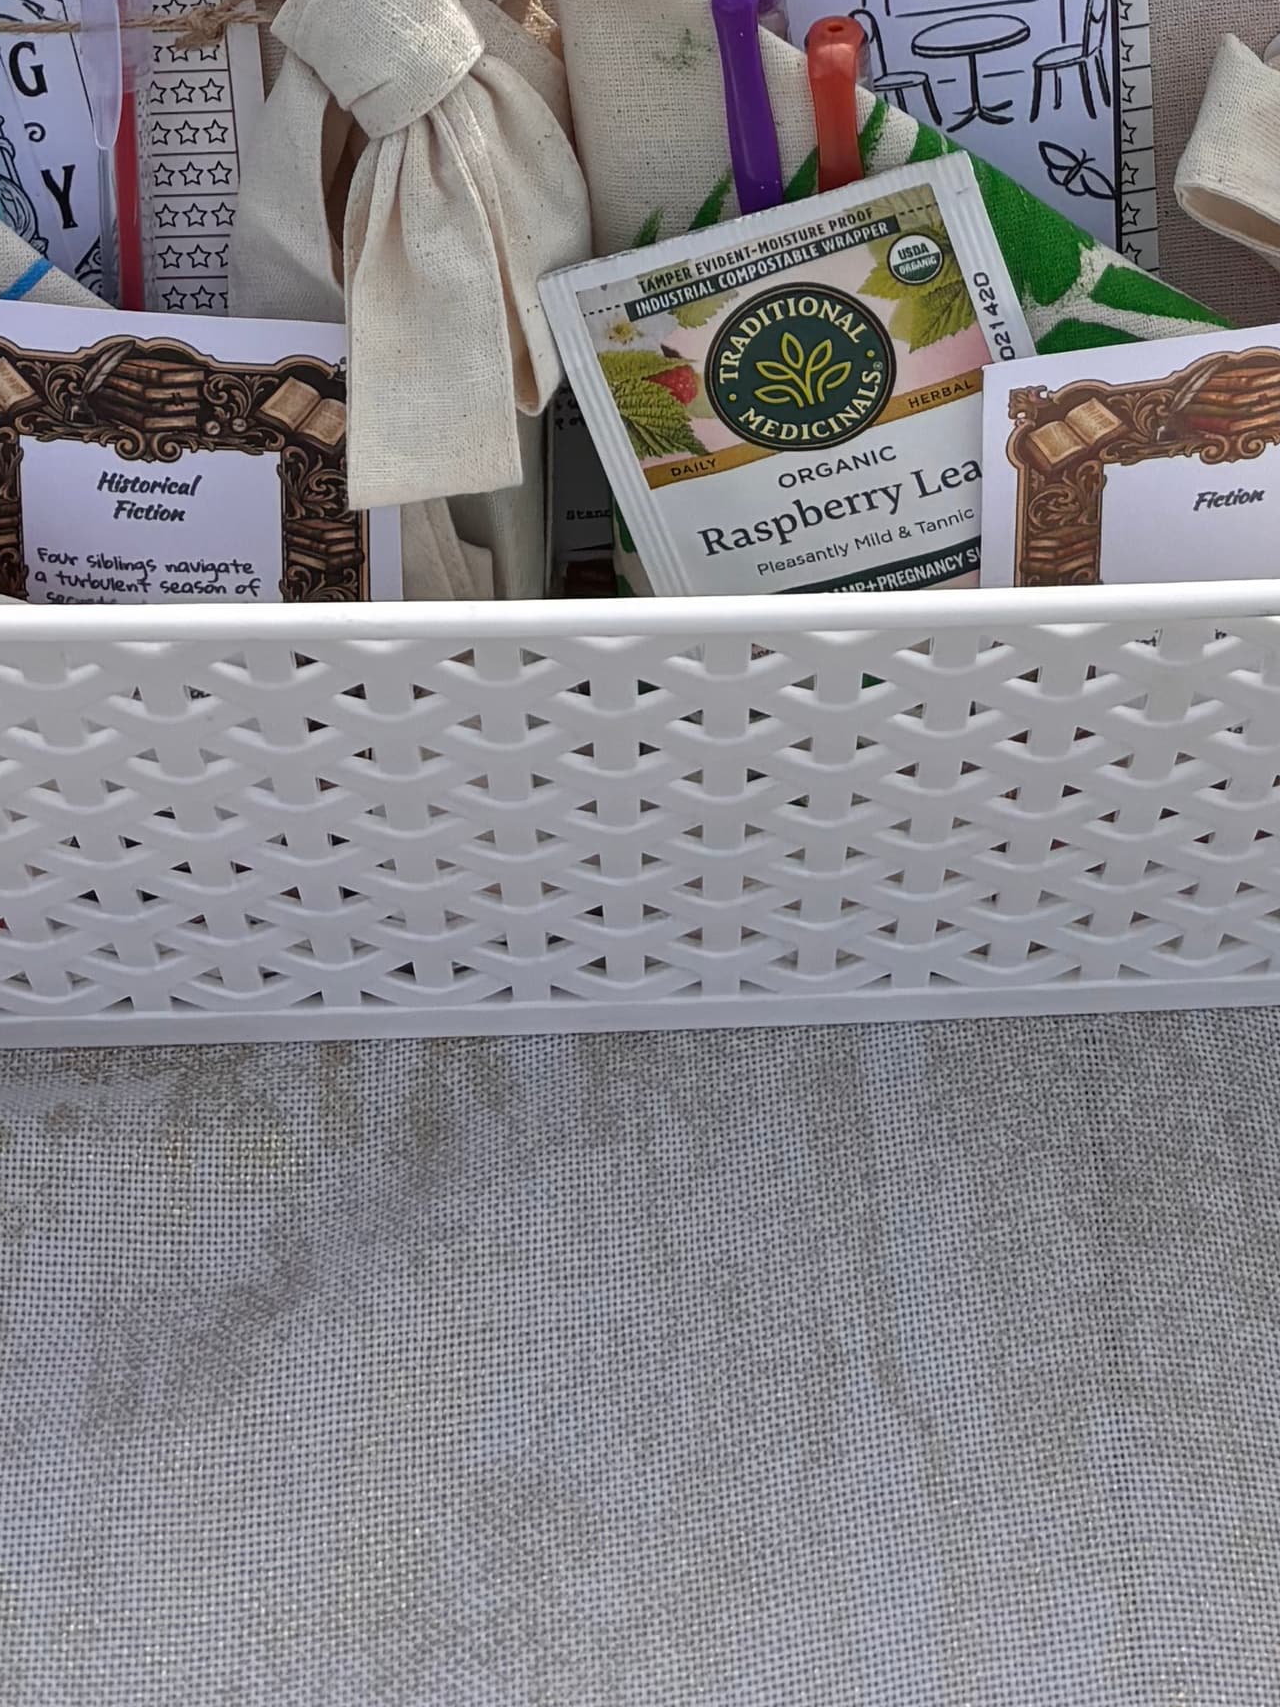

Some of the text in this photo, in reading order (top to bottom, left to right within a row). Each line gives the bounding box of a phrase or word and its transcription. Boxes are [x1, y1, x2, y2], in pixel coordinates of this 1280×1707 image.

[637, 209, 873, 294] TAMPER EVIDENT-MOISTURE PROOF
[897, 242, 930, 260] USDA
[899, 256, 937, 275] ORGANIC
[635, 221, 889, 317] INDUSTRIAL COMPOSTABLE WRAPPER
[719, 296, 868, 384] TRADITIONAL
[738, 369, 882, 440] MEDICINALS
[908, 378, 975, 410] HERBAL
[96, 470, 202, 497] Historical
[670, 458, 717, 478] DAILY
[778, 445, 897, 488] ORGANIC
[113, 499, 186, 522] Fiction
[697, 459, 983, 557] Raspberry Lea
[1192, 486, 1265, 512] Fiction
[756, 508, 975, 577] Pleasantly Mild & Tannic
[37, 547, 255, 583] Four siblings navigate
[34, 570, 261, 598] a turbulent season of
